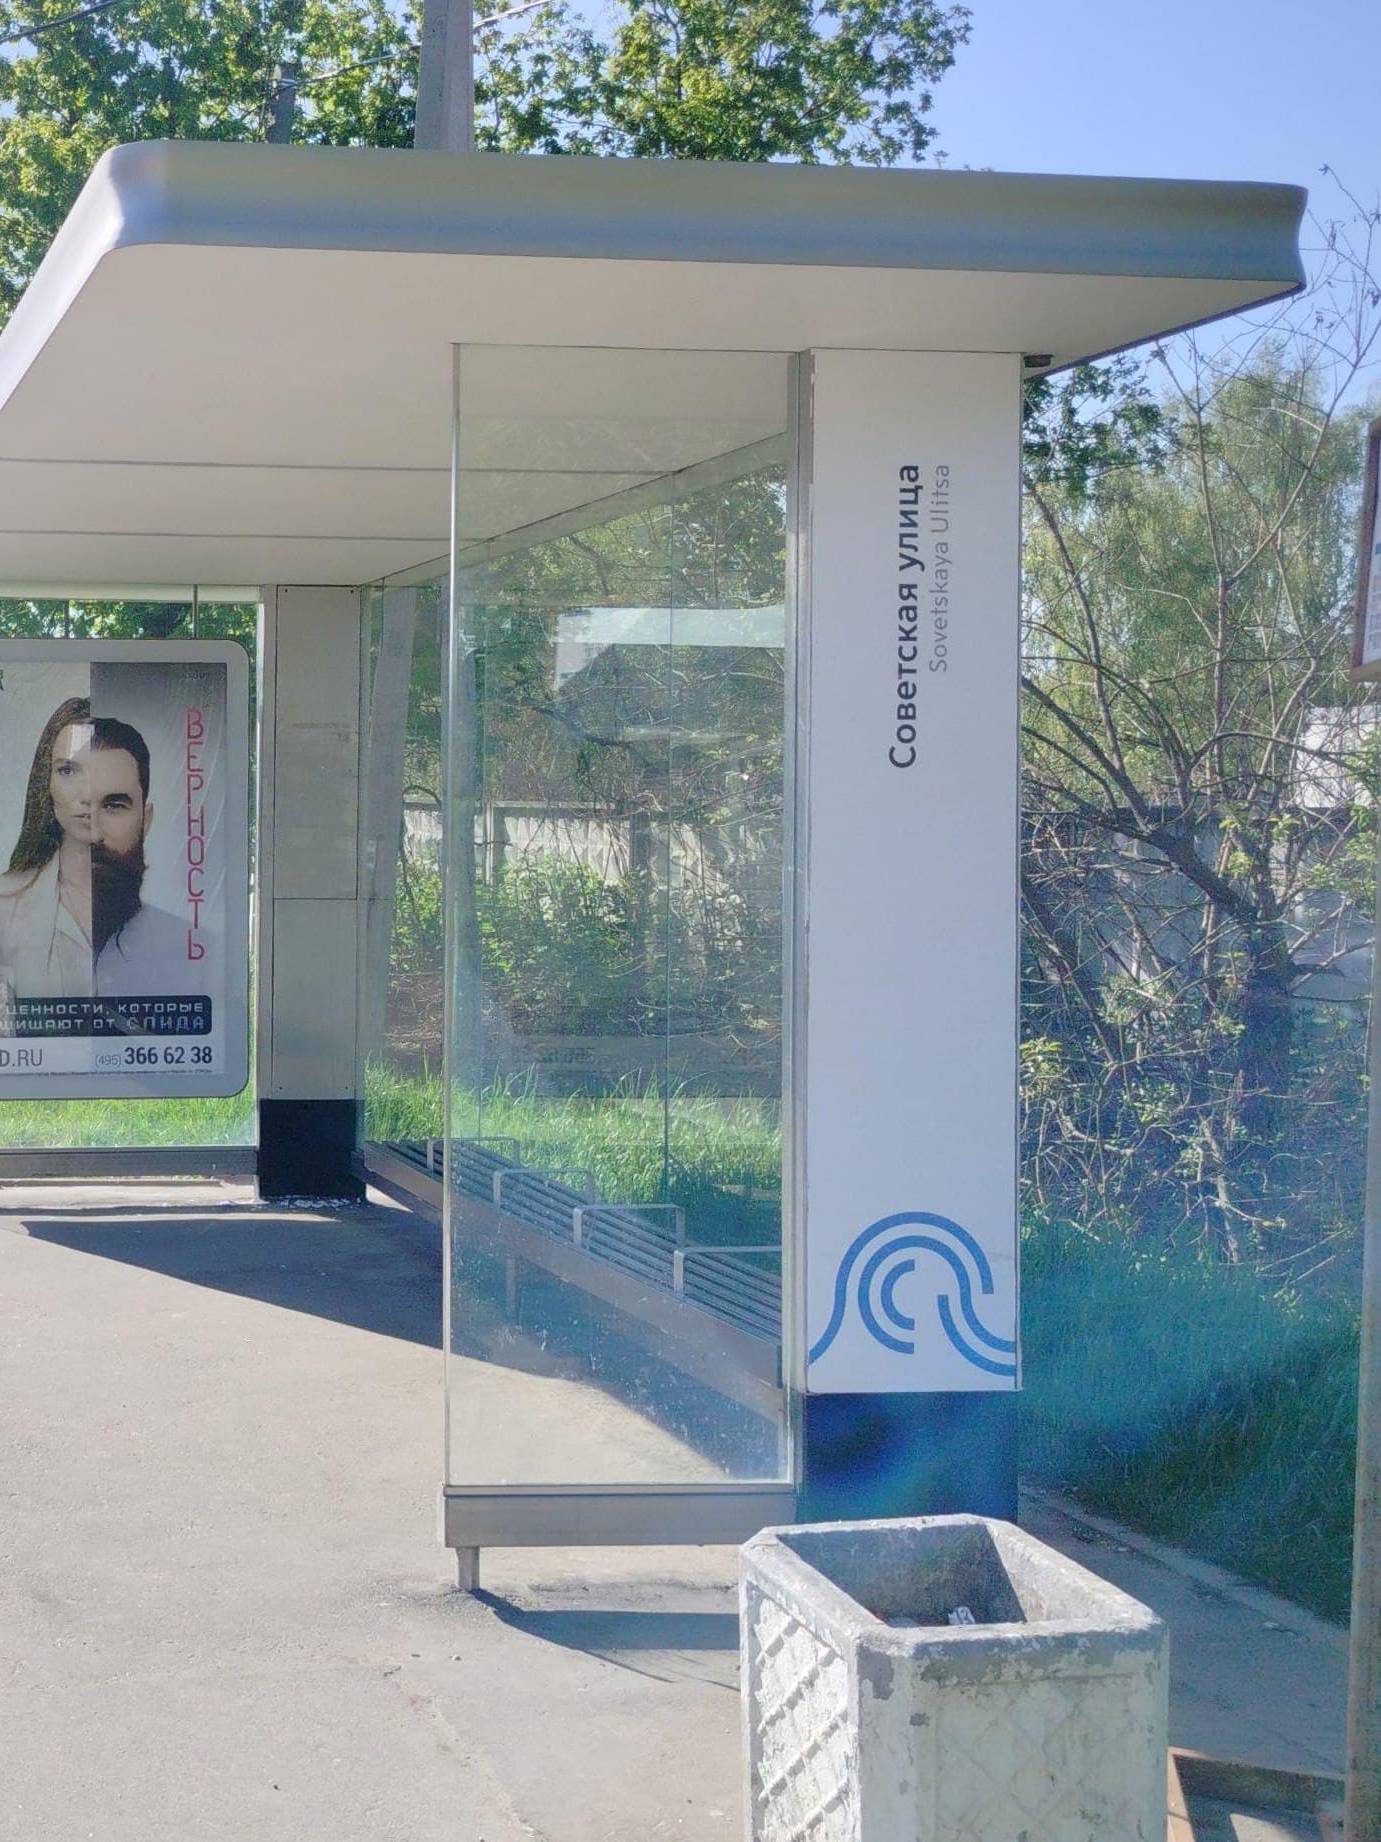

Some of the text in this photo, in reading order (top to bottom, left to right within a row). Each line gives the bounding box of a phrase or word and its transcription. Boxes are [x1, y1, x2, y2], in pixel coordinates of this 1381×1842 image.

[929, 464, 953, 673] Sovetskaya Ulitsa
[889, 464, 925, 769] Советская улица
[118, 1002, 204, 1014] КОТОРЫЕ
[93, 1018, 116, 1029] ОТ
[127, 1016, 205, 1031] СПИДА
[95, 1045, 213, 1068] (495) 366 62 38
